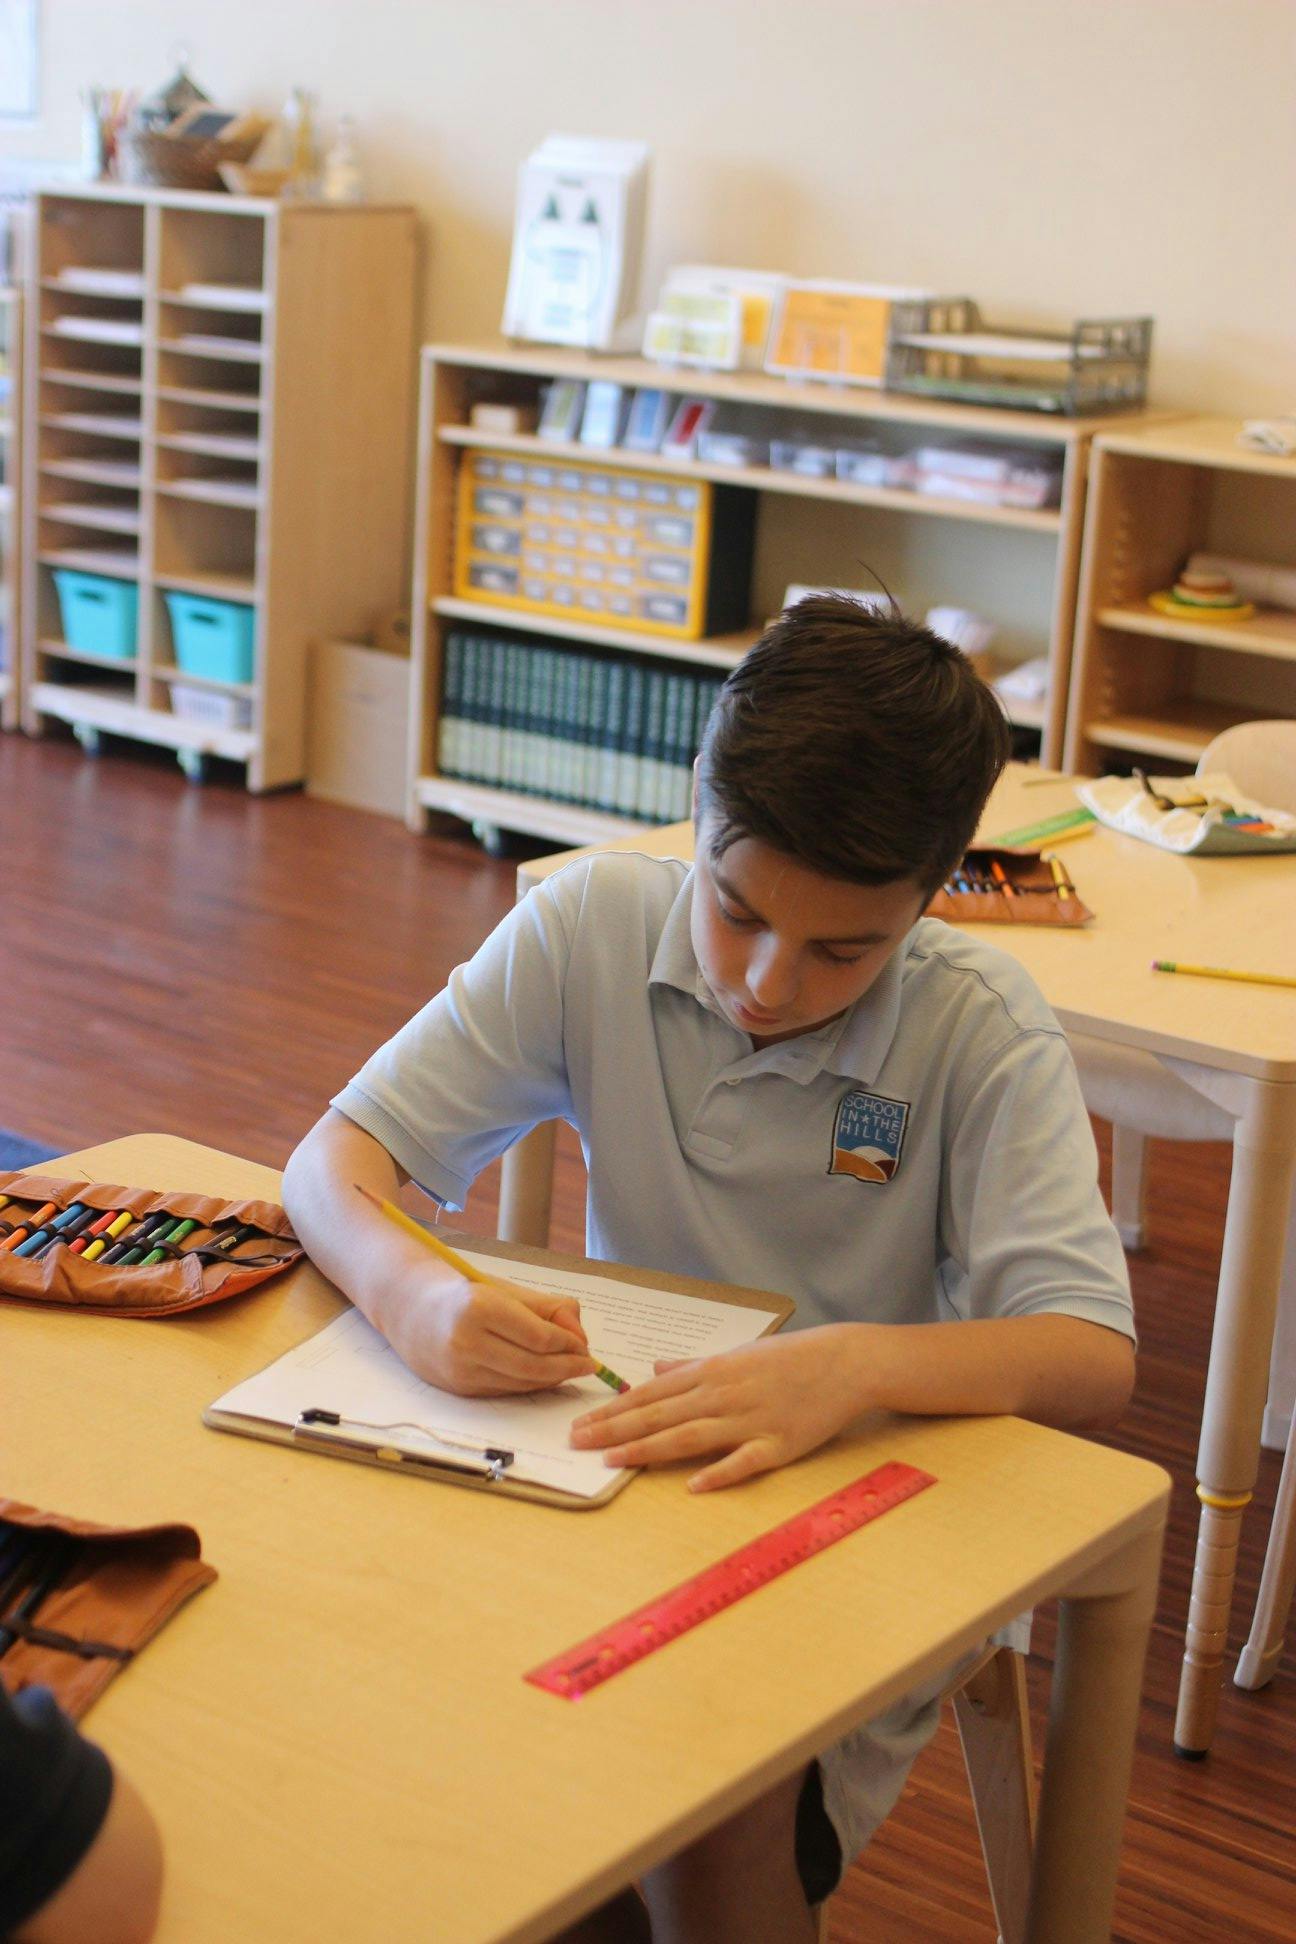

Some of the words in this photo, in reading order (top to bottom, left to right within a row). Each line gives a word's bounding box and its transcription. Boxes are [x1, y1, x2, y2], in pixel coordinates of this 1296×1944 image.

[845, 1096, 900, 1119] SCHOOL
[840, 1120, 897, 1143] HILLS
[842, 1109, 858, 1121] IN
[872, 1115, 900, 1131] THE
